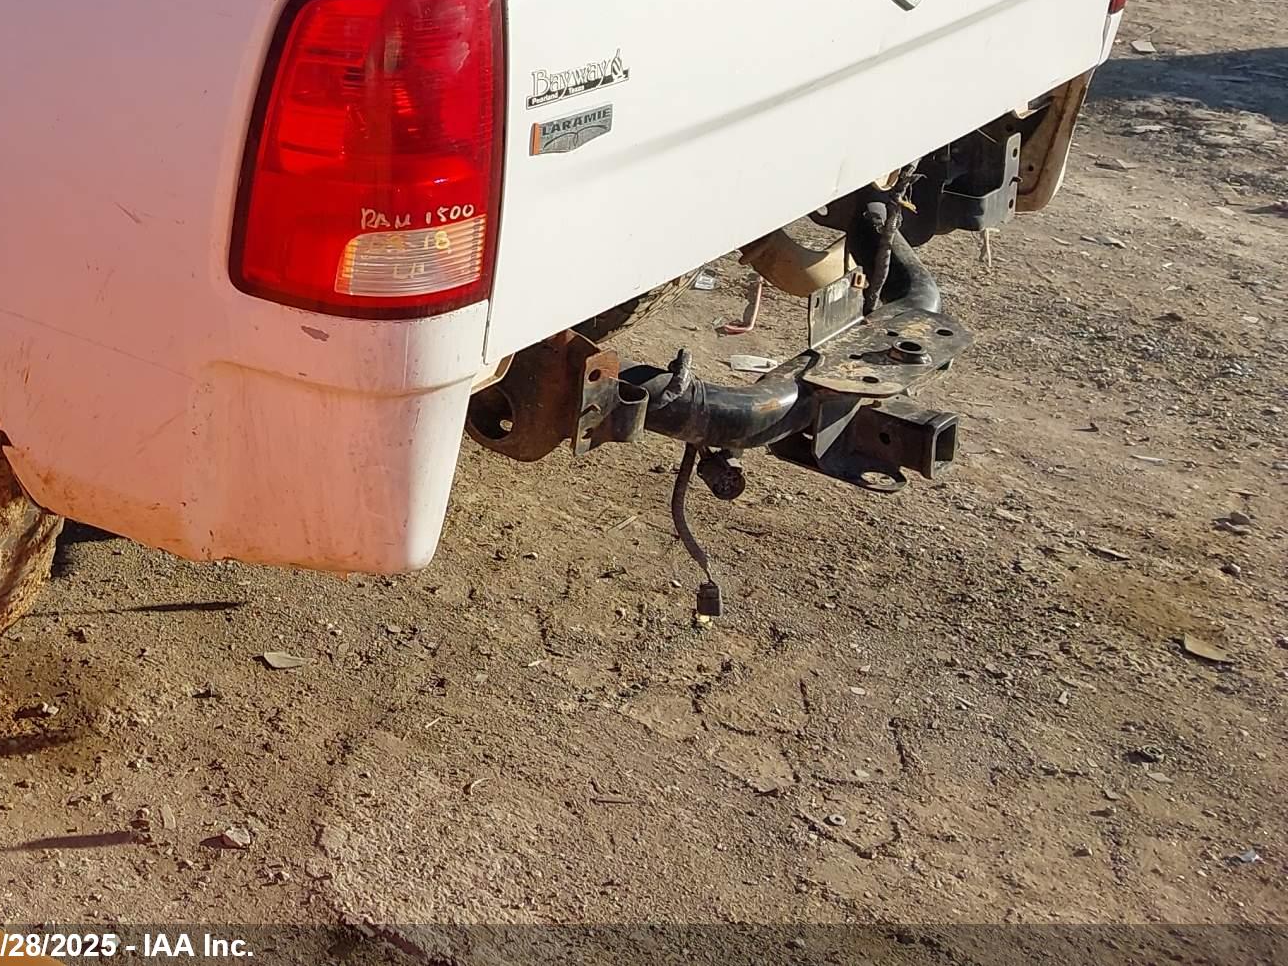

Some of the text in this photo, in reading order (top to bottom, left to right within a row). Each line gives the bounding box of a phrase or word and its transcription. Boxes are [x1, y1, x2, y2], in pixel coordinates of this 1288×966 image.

[531, 57, 611, 99] Bayway
[542, 107, 612, 136] LARAMIE
[425, 204, 475, 225] 1500
